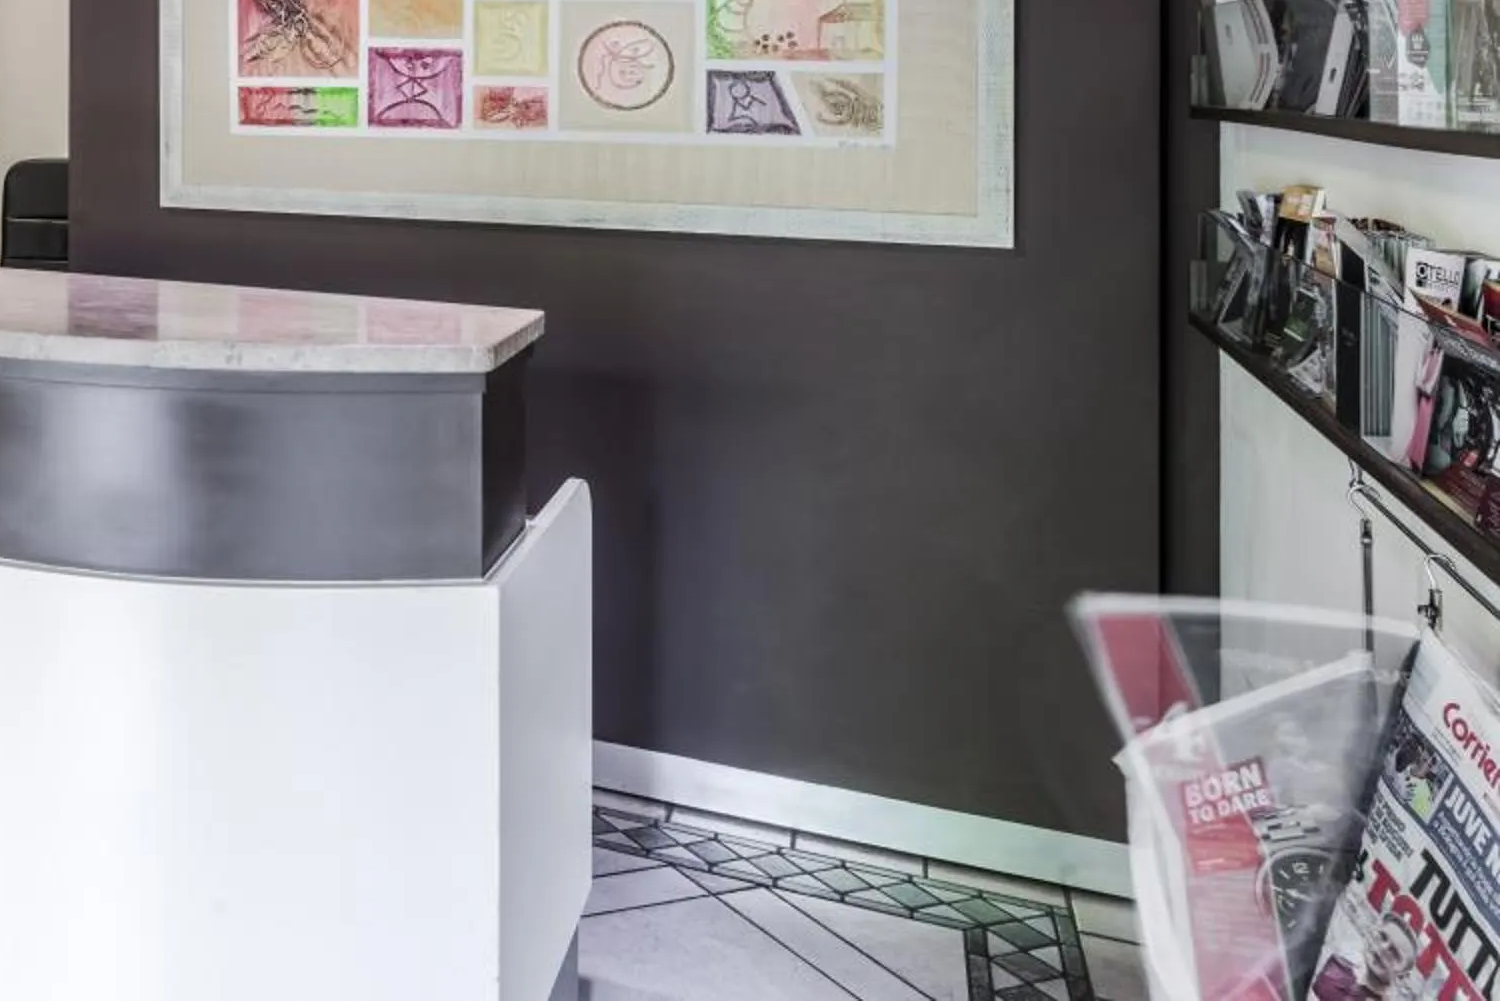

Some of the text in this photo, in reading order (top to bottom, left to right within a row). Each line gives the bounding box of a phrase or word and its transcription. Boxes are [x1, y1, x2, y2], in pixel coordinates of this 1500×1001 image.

[1184, 762, 1263, 807] BORN
[1187, 787, 1274, 825] TO DARE
[1443, 786, 1493, 857] JUVE
